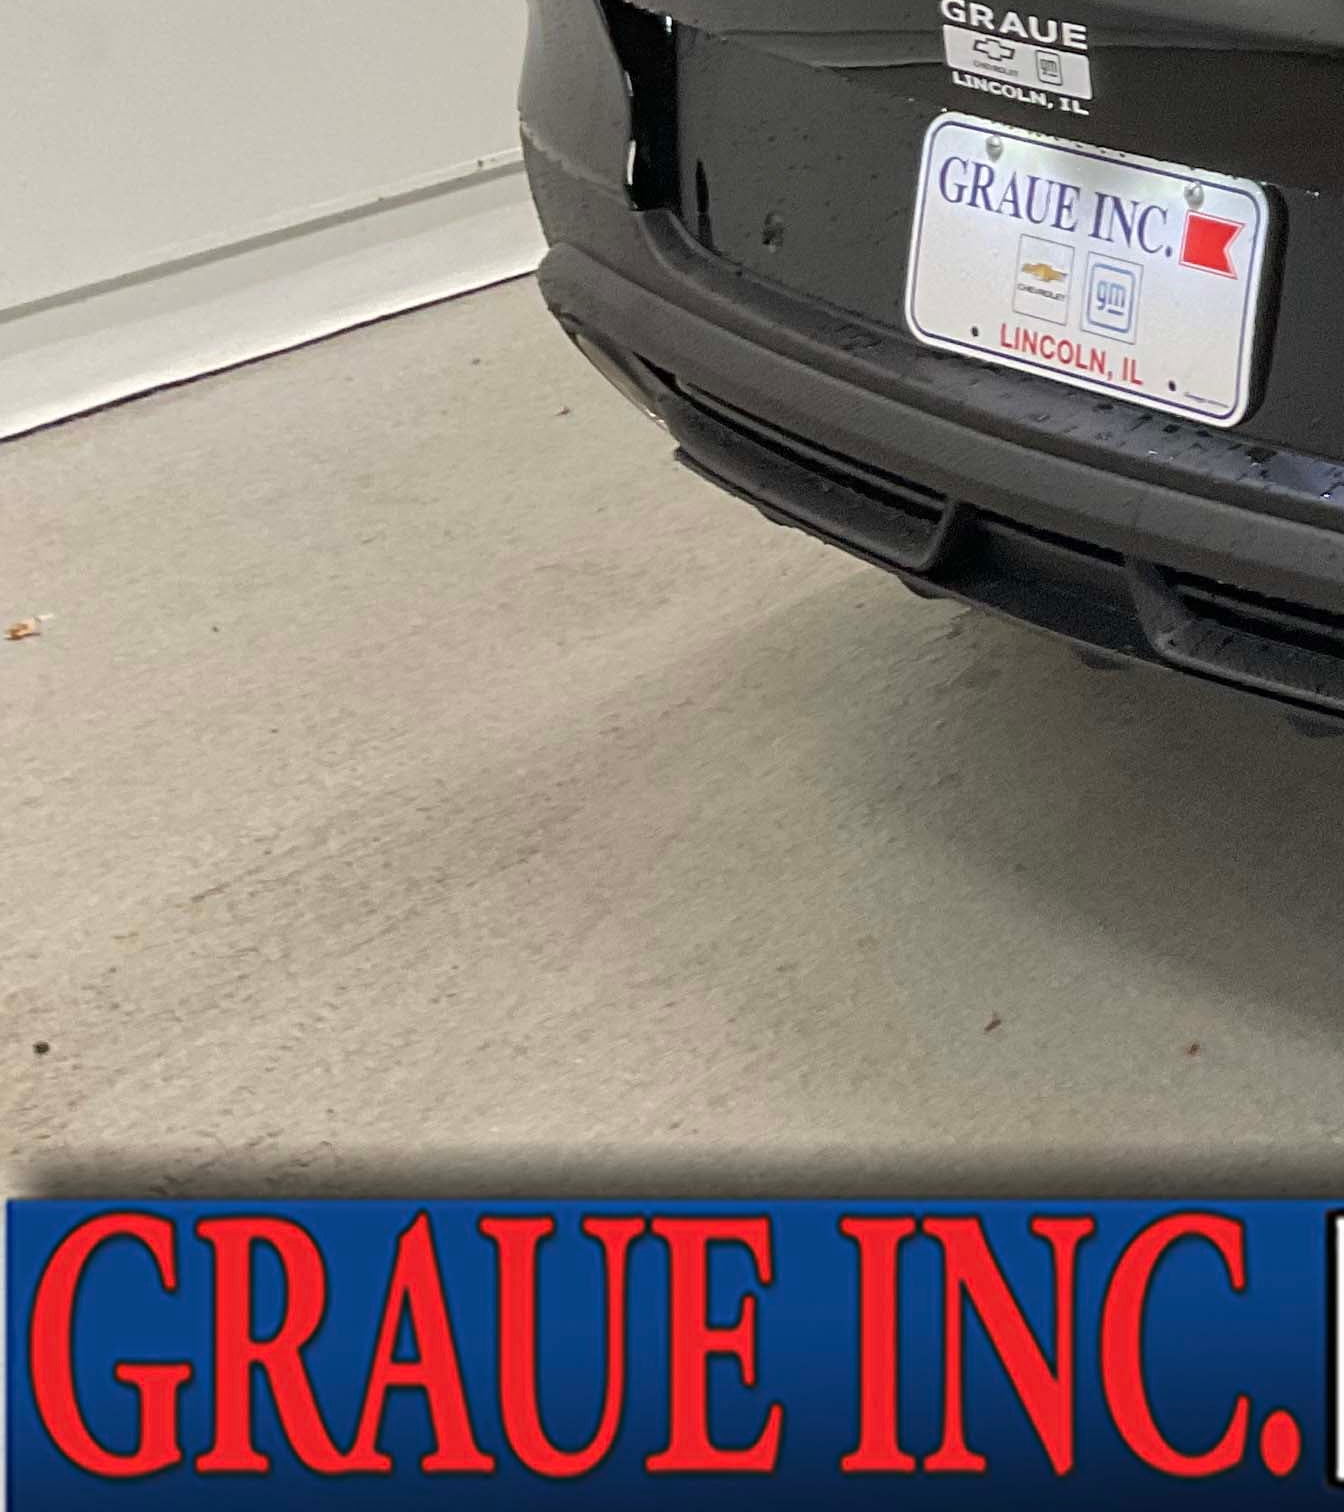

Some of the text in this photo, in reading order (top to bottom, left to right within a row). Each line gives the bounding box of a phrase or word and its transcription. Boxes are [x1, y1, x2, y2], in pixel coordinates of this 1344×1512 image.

[952, 71, 1090, 116] LINCOLN, IL
[939, 156, 1173, 259] GRAUE INC.
[1000, 323, 1144, 386] LINCOLN, IL
